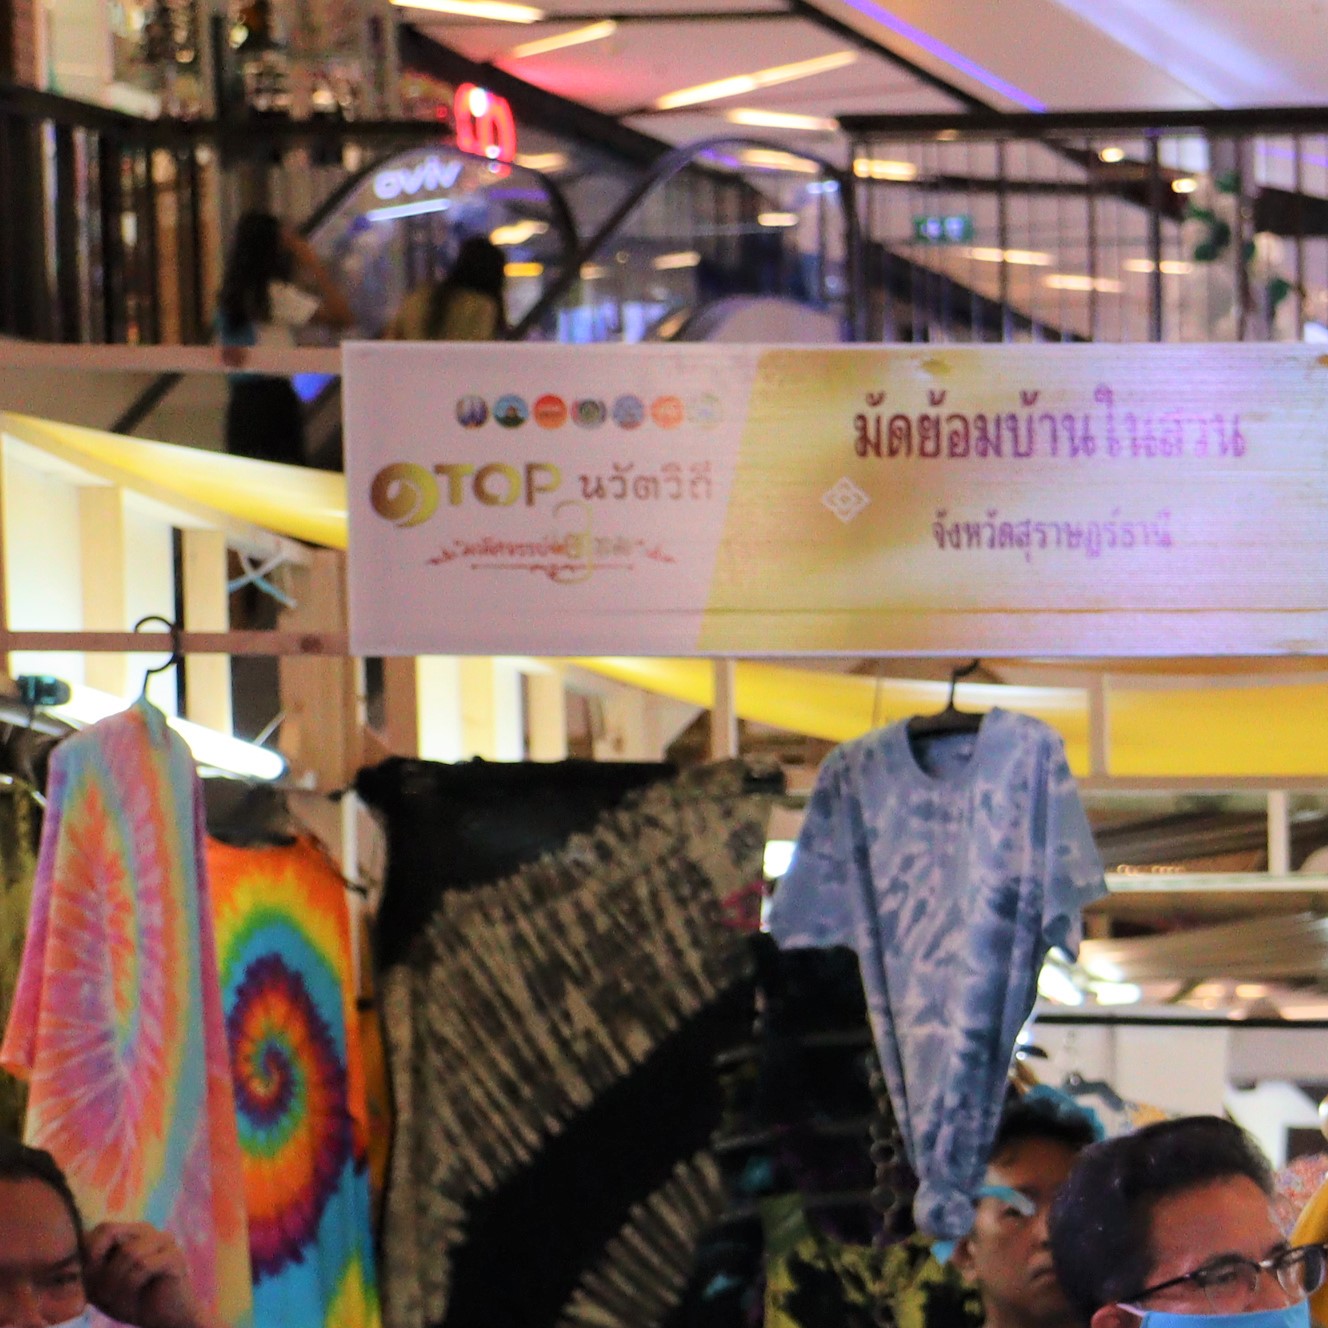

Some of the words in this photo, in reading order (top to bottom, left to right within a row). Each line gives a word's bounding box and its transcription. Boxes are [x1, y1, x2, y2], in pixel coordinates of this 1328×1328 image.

[853, 383, 1248, 459] มัดย้อมบ้านในสวน
[370, 461, 563, 528] OTOP
[578, 460, 715, 501] นวัตวิถี
[931, 507, 1172, 562] จังหวัดสุราษฎร์ธานี
